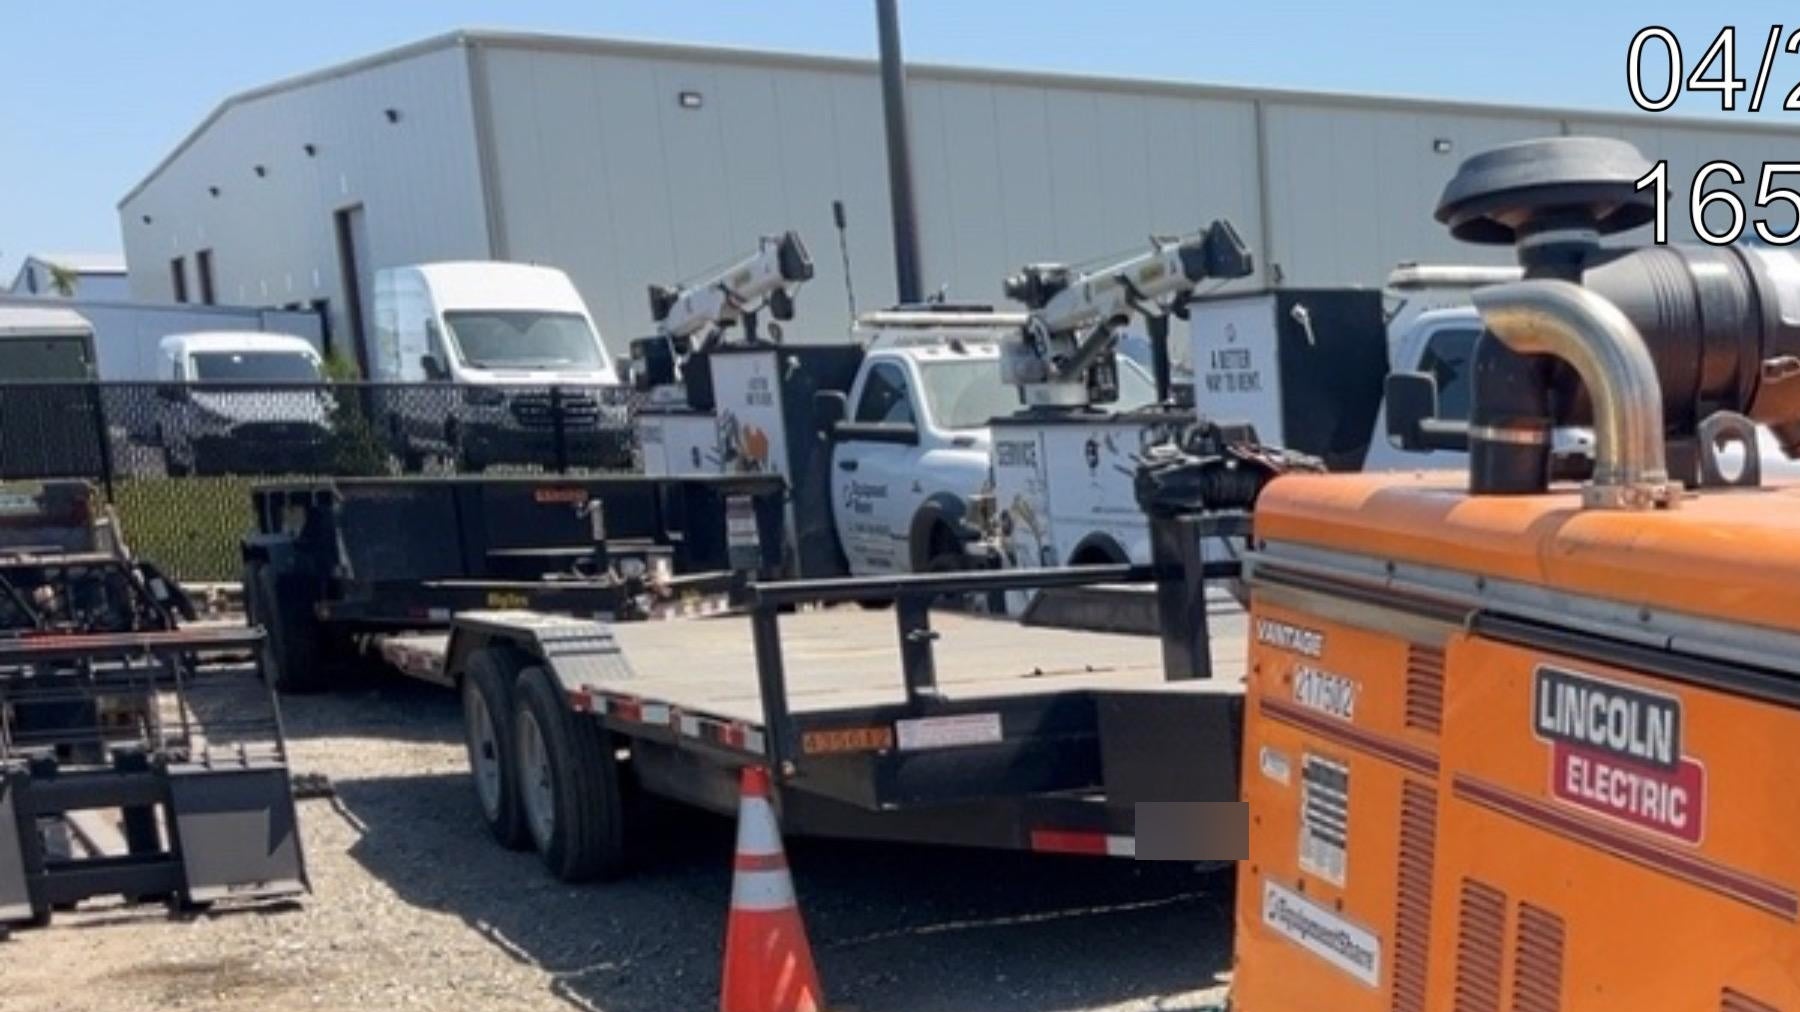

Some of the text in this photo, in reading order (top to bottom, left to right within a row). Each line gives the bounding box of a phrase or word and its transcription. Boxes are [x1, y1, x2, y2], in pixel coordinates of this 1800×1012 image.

[1256, 617, 1324, 659] VANTAGE
[1540, 679, 1673, 765] LINCOLN
[1566, 754, 1687, 829] ELECTRIC
